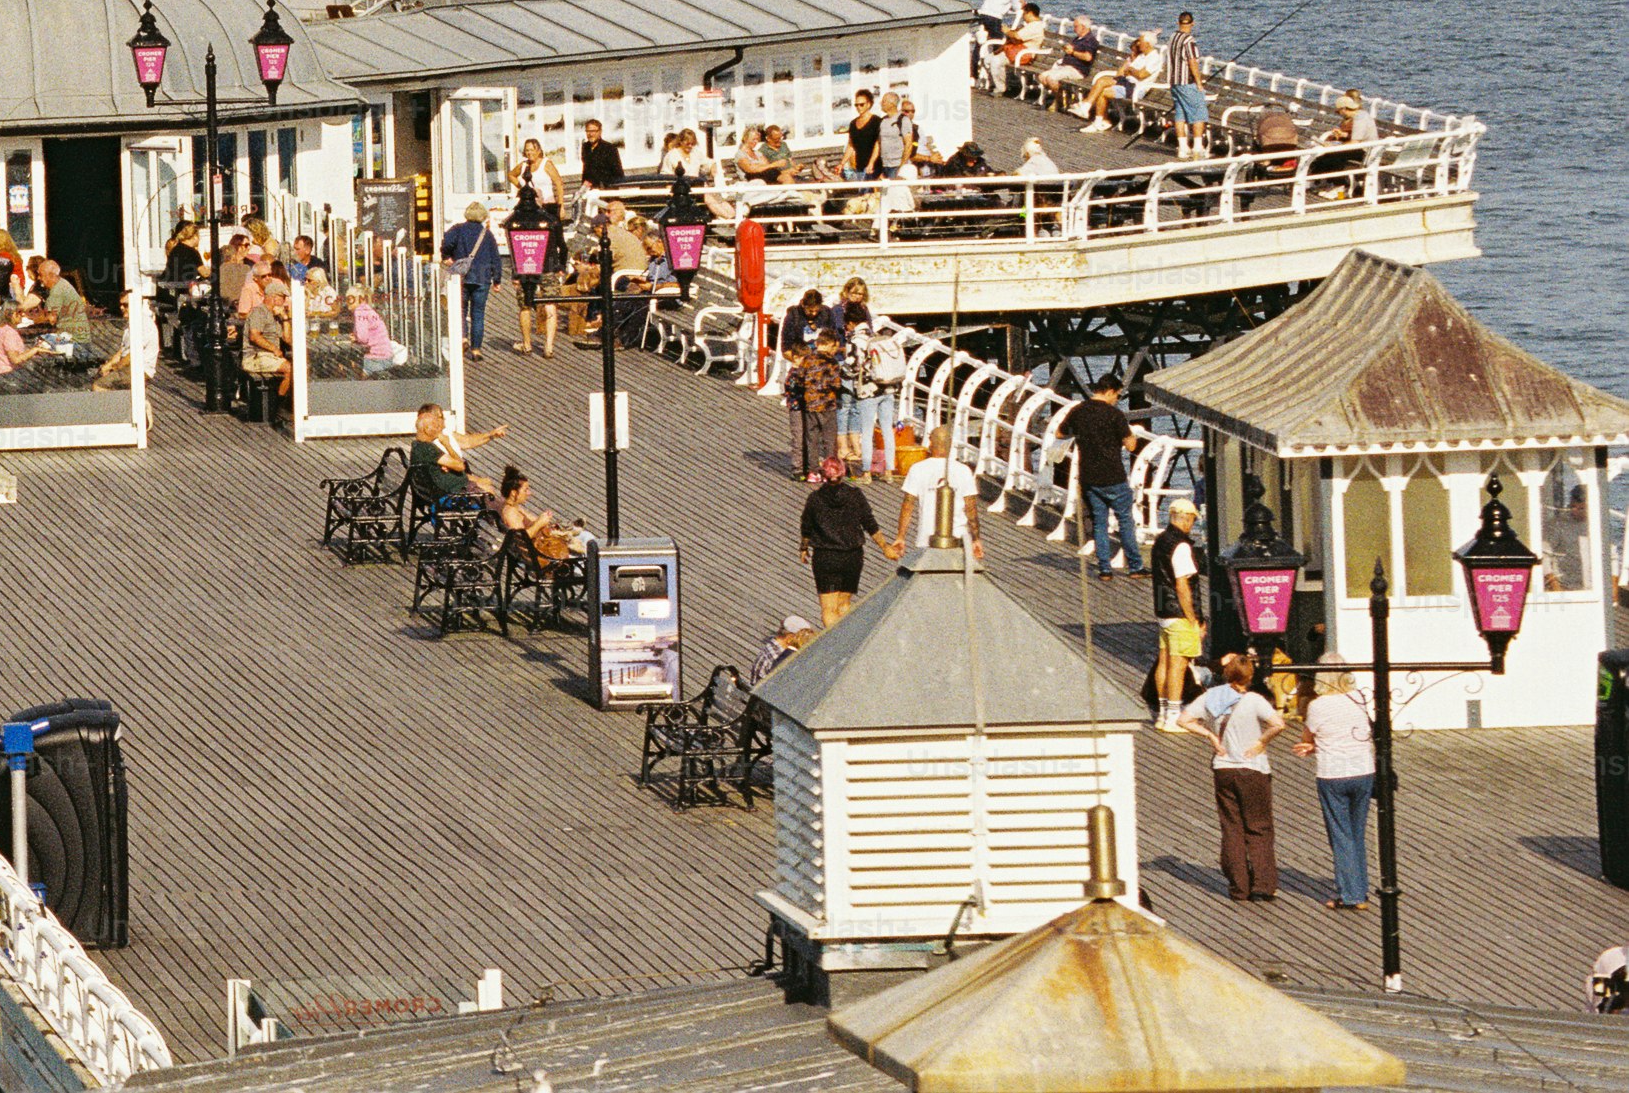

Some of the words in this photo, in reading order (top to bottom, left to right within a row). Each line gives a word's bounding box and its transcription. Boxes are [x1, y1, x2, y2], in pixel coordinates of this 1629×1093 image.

[670, 229, 701, 237] CROMER
[514, 234, 545, 242] CROMER
[1244, 575, 1290, 584] CROMER
[1477, 574, 1524, 583] CROMER
[1254, 585, 1280, 594] PIER
[1487, 584, 1513, 592] PIER
[1259, 596, 1276, 604] 125
[1492, 594, 1510, 602] 125
